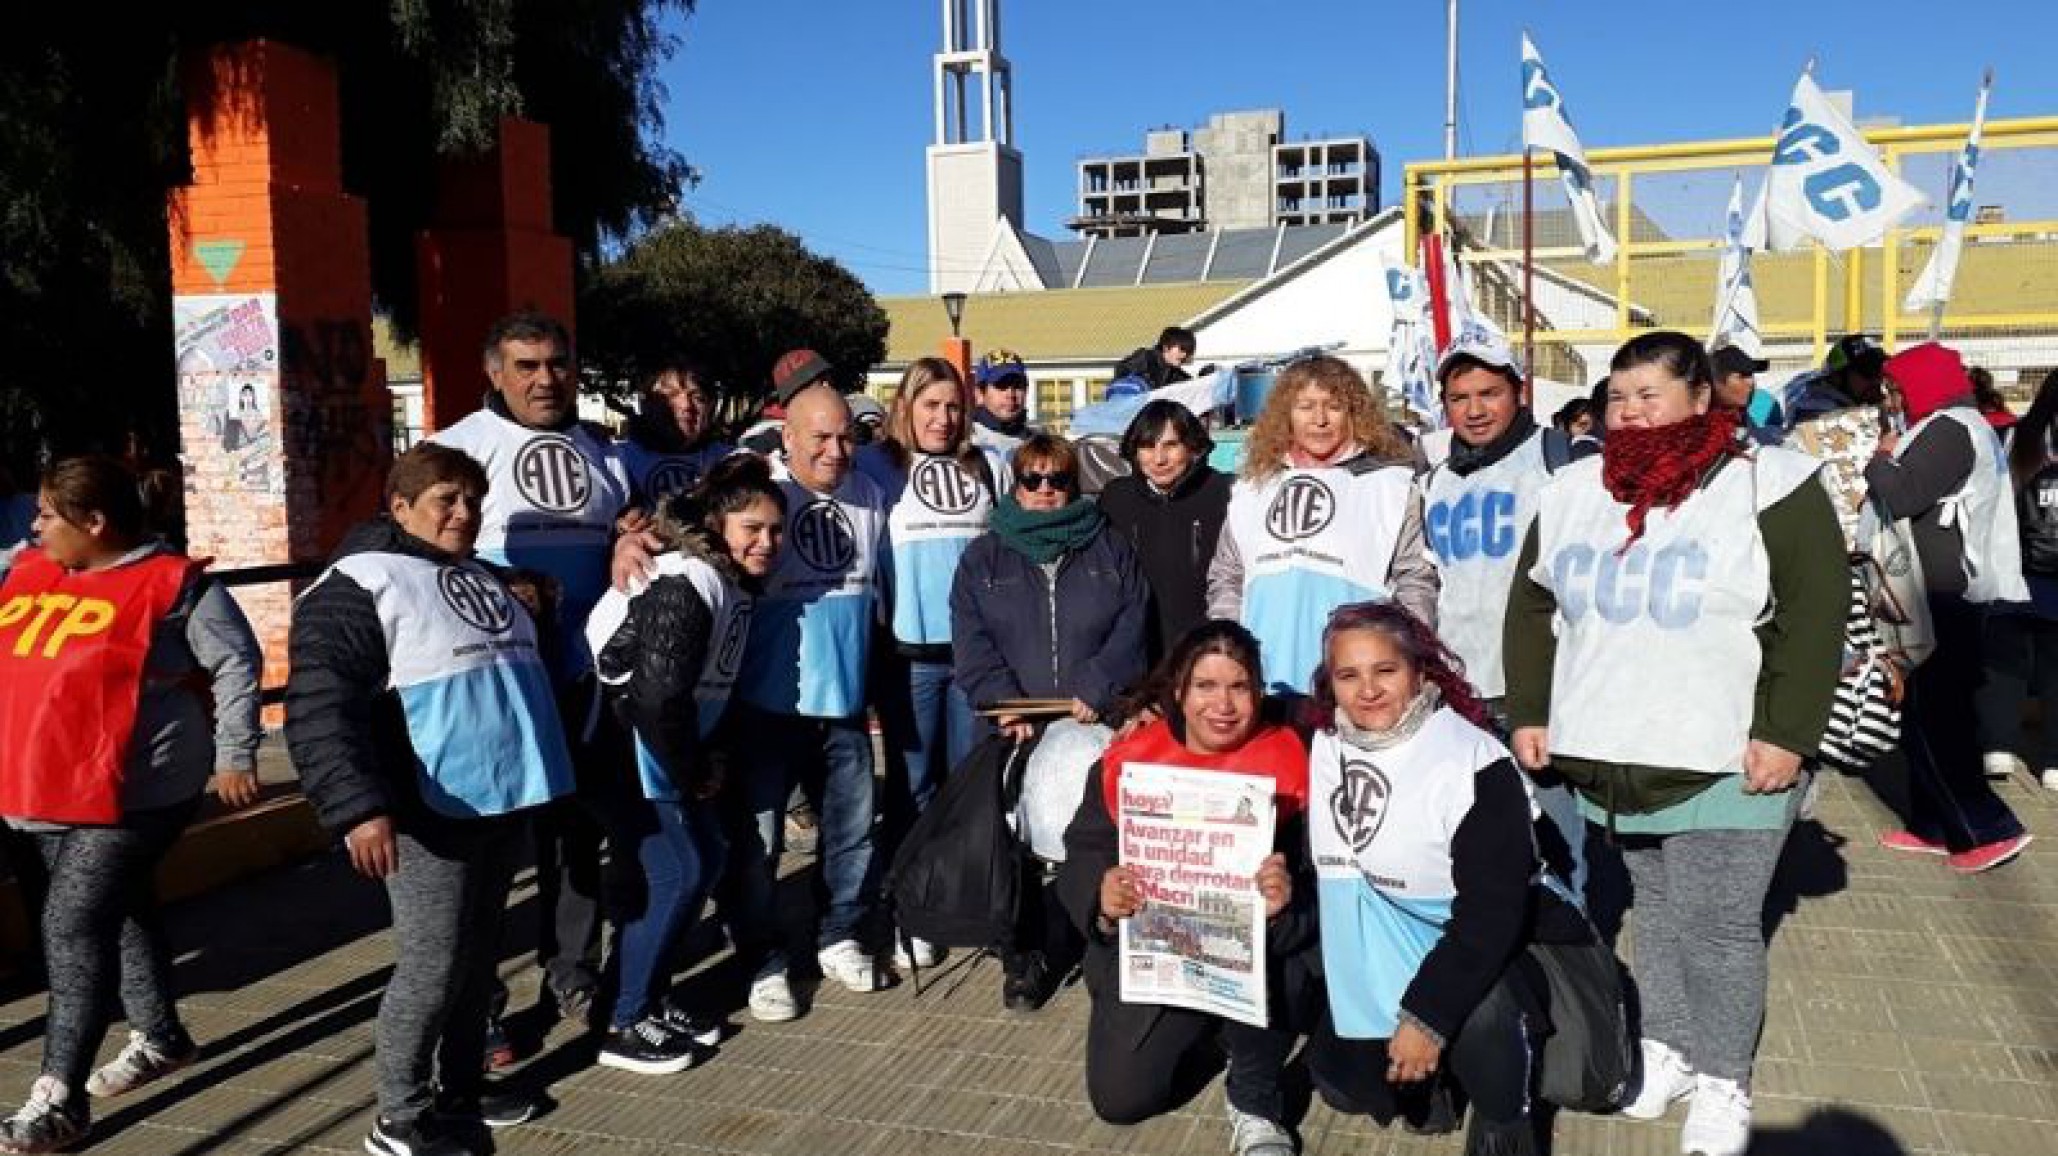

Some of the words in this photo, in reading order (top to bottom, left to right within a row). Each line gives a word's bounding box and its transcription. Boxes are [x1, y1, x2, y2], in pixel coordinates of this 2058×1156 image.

[521, 442, 587, 507] ATE
[920, 460, 974, 510] ATE
[799, 506, 851, 564] ATE
[1272, 481, 1326, 538] ATE
[1427, 491, 1516, 567] CCC
[446, 569, 512, 628] ATE
[1553, 537, 1709, 630] CCC
[1124, 819, 1204, 845] Avanzar
[1208, 832, 1236, 848] en
[1124, 834, 1141, 858] la
[1144, 841, 1215, 866] unidad
[1143, 880, 1195, 907] Macri
